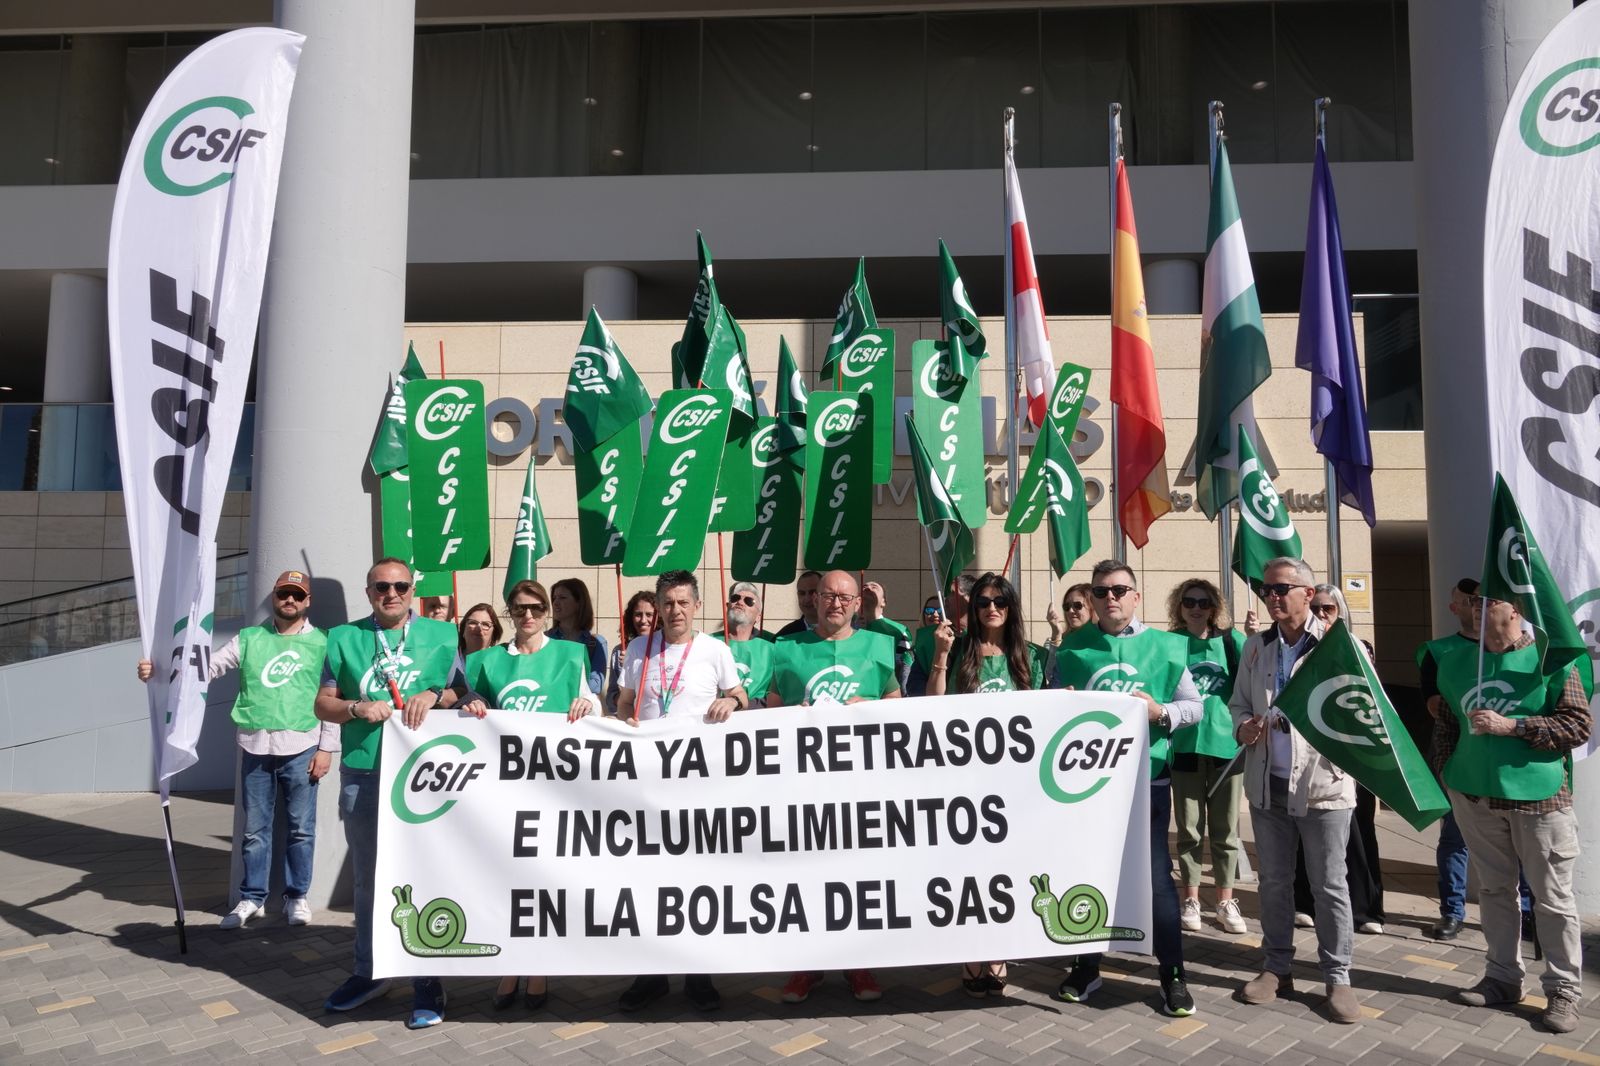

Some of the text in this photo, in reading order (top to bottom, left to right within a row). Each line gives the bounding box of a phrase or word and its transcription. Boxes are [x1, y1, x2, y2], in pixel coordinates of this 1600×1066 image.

[1545, 87, 1600, 123] CS
[170, 125, 267, 163] CSIF
[849, 346, 888, 363] CSIF
[571, 356, 611, 394] CSIF
[427, 403, 476, 423] CSIF
[1061, 385, 1084, 406] CSIF
[672, 408, 722, 428] CSIF
[825, 413, 866, 432] CSIF
[437, 446, 462, 565] CSIF
[601, 448, 624, 558] CSIF
[646, 449, 697, 568] CSIF
[826, 454, 851, 565] CSIF
[752, 474, 781, 576] CSIF
[270, 662, 304, 677] CSIF
[504, 695, 548, 712] CSIF
[813, 681, 860, 700] CSIF
[499, 715, 1035, 782] BASTA YA DE RETRASOS
[1058, 737, 1134, 772] CSIF
[410, 761, 486, 793] CSIF
[513, 794, 1009, 858] E INCLUMPLIMIENTOS
[510, 873, 1016, 938] EN LA BOLSA DEL SAS
[480, 945, 498, 954] SAS
[1124, 930, 1143, 939] SAS
